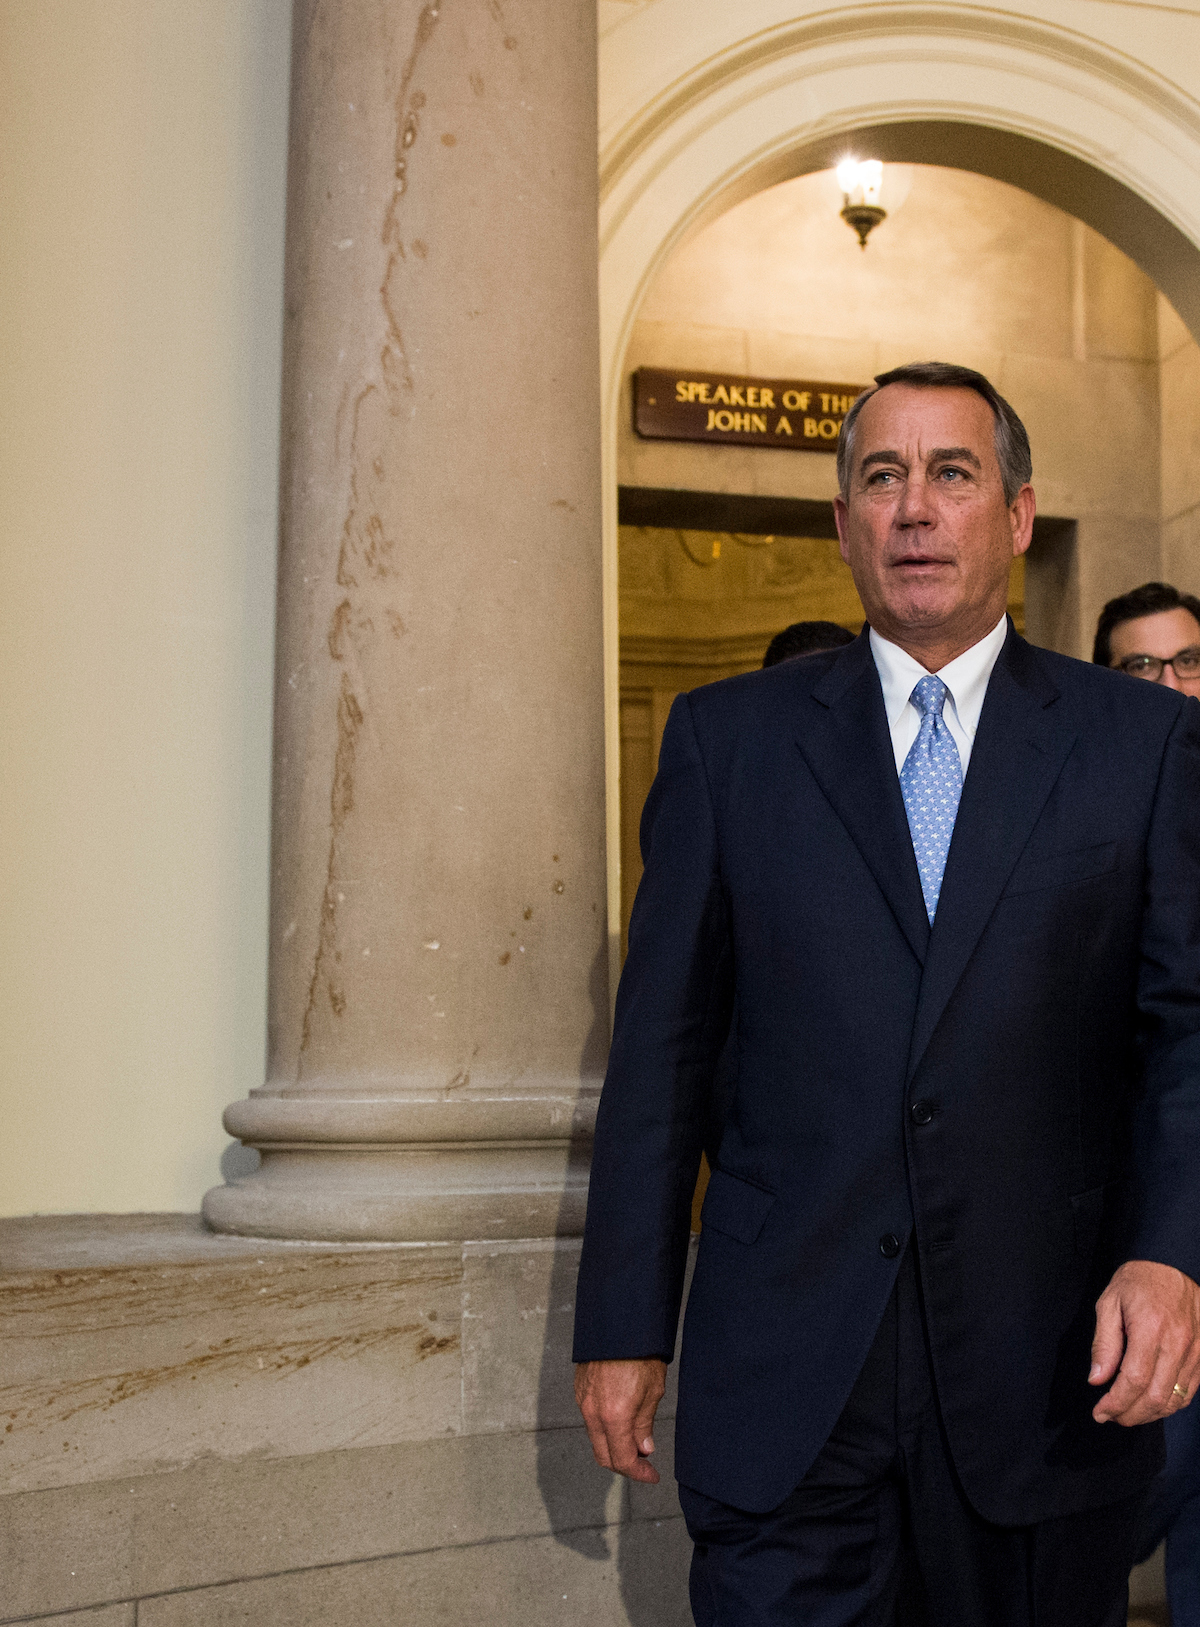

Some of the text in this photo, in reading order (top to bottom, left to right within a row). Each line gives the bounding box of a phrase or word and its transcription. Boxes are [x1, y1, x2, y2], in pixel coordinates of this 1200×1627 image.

[675, 380, 776, 409] SPEAKER
[782, 389, 811, 412] OF
[706, 409, 842, 440] JOHN A BO
